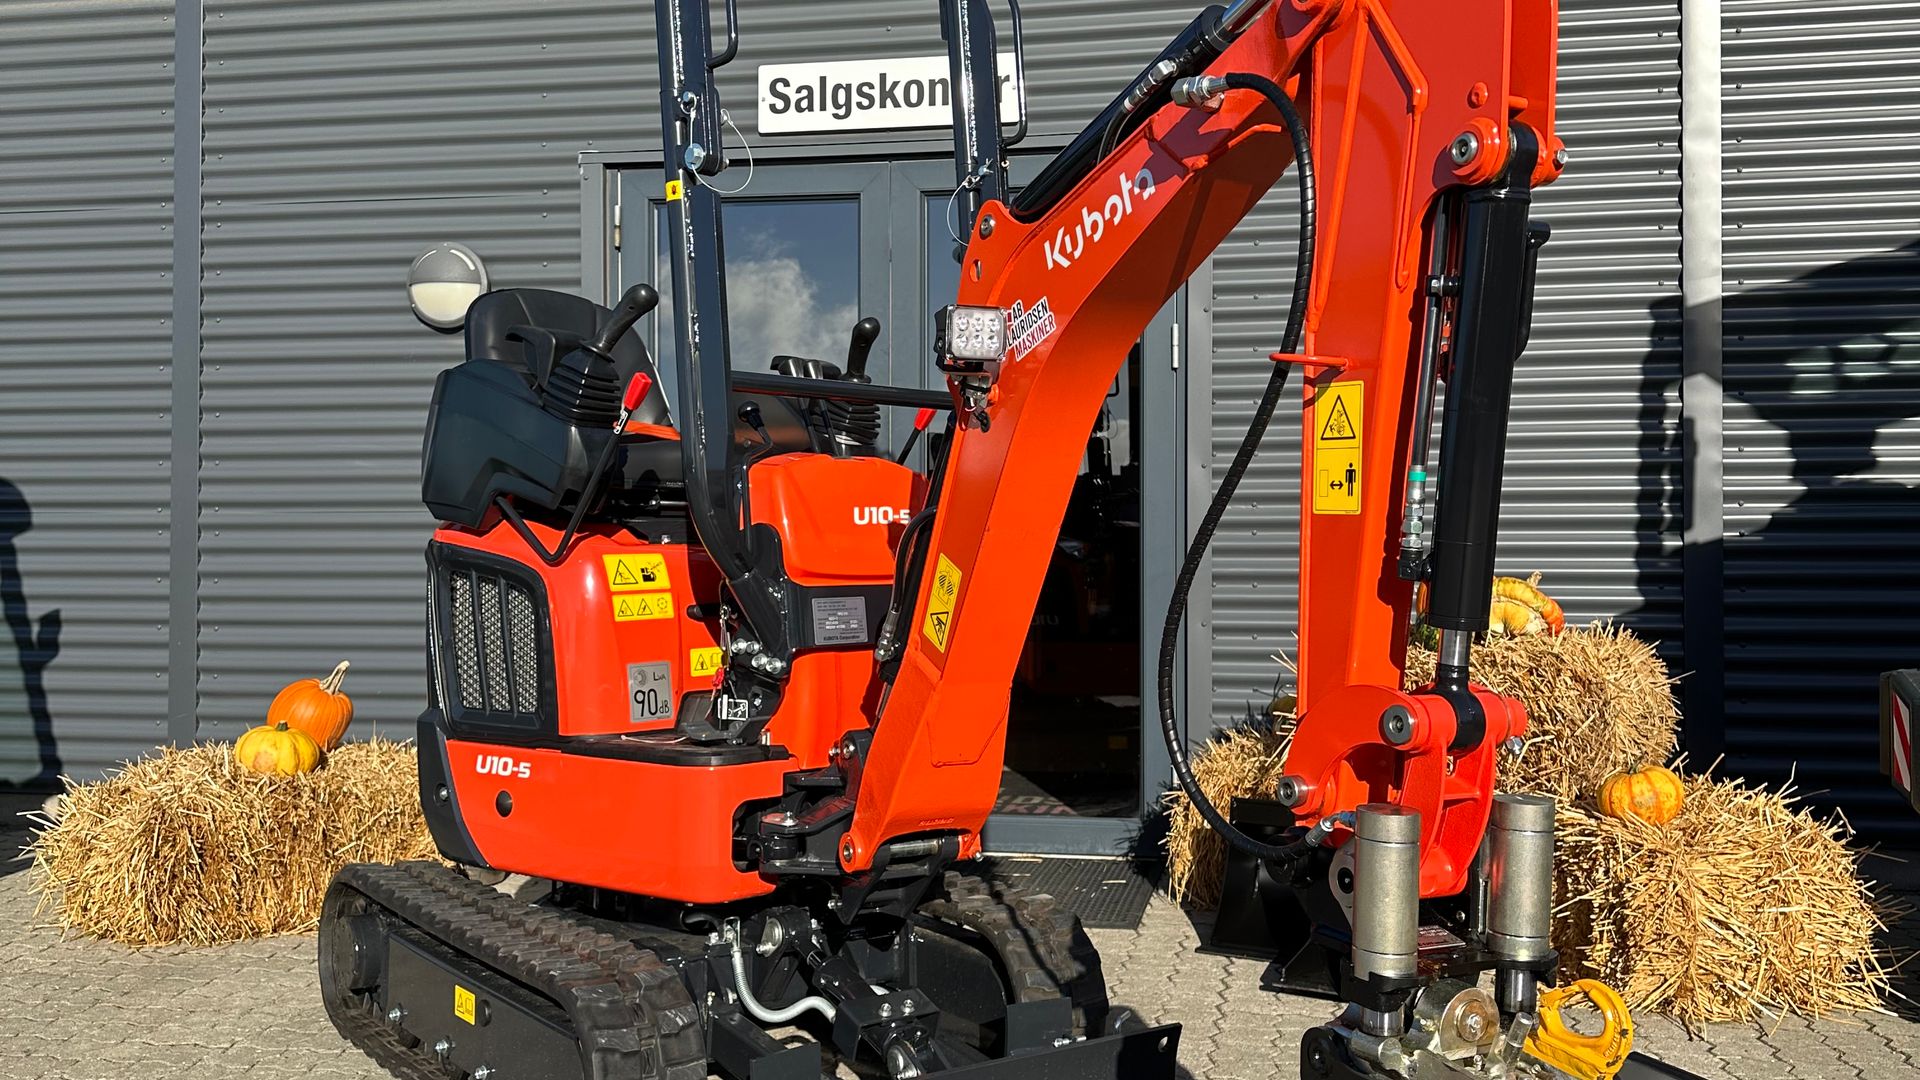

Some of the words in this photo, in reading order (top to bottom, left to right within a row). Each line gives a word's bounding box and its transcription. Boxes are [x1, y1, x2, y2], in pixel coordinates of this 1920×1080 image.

[768, 73, 1010, 120] Salgskonr
[1044, 168, 1156, 270] Kubota
[1007, 298, 1048, 347] LAURIDSEN
[1012, 302, 1023, 323] AB
[1015, 314, 1056, 359] MASKINER
[853, 506, 911, 526] U10-5
[475, 754, 532, 779] U10-5
